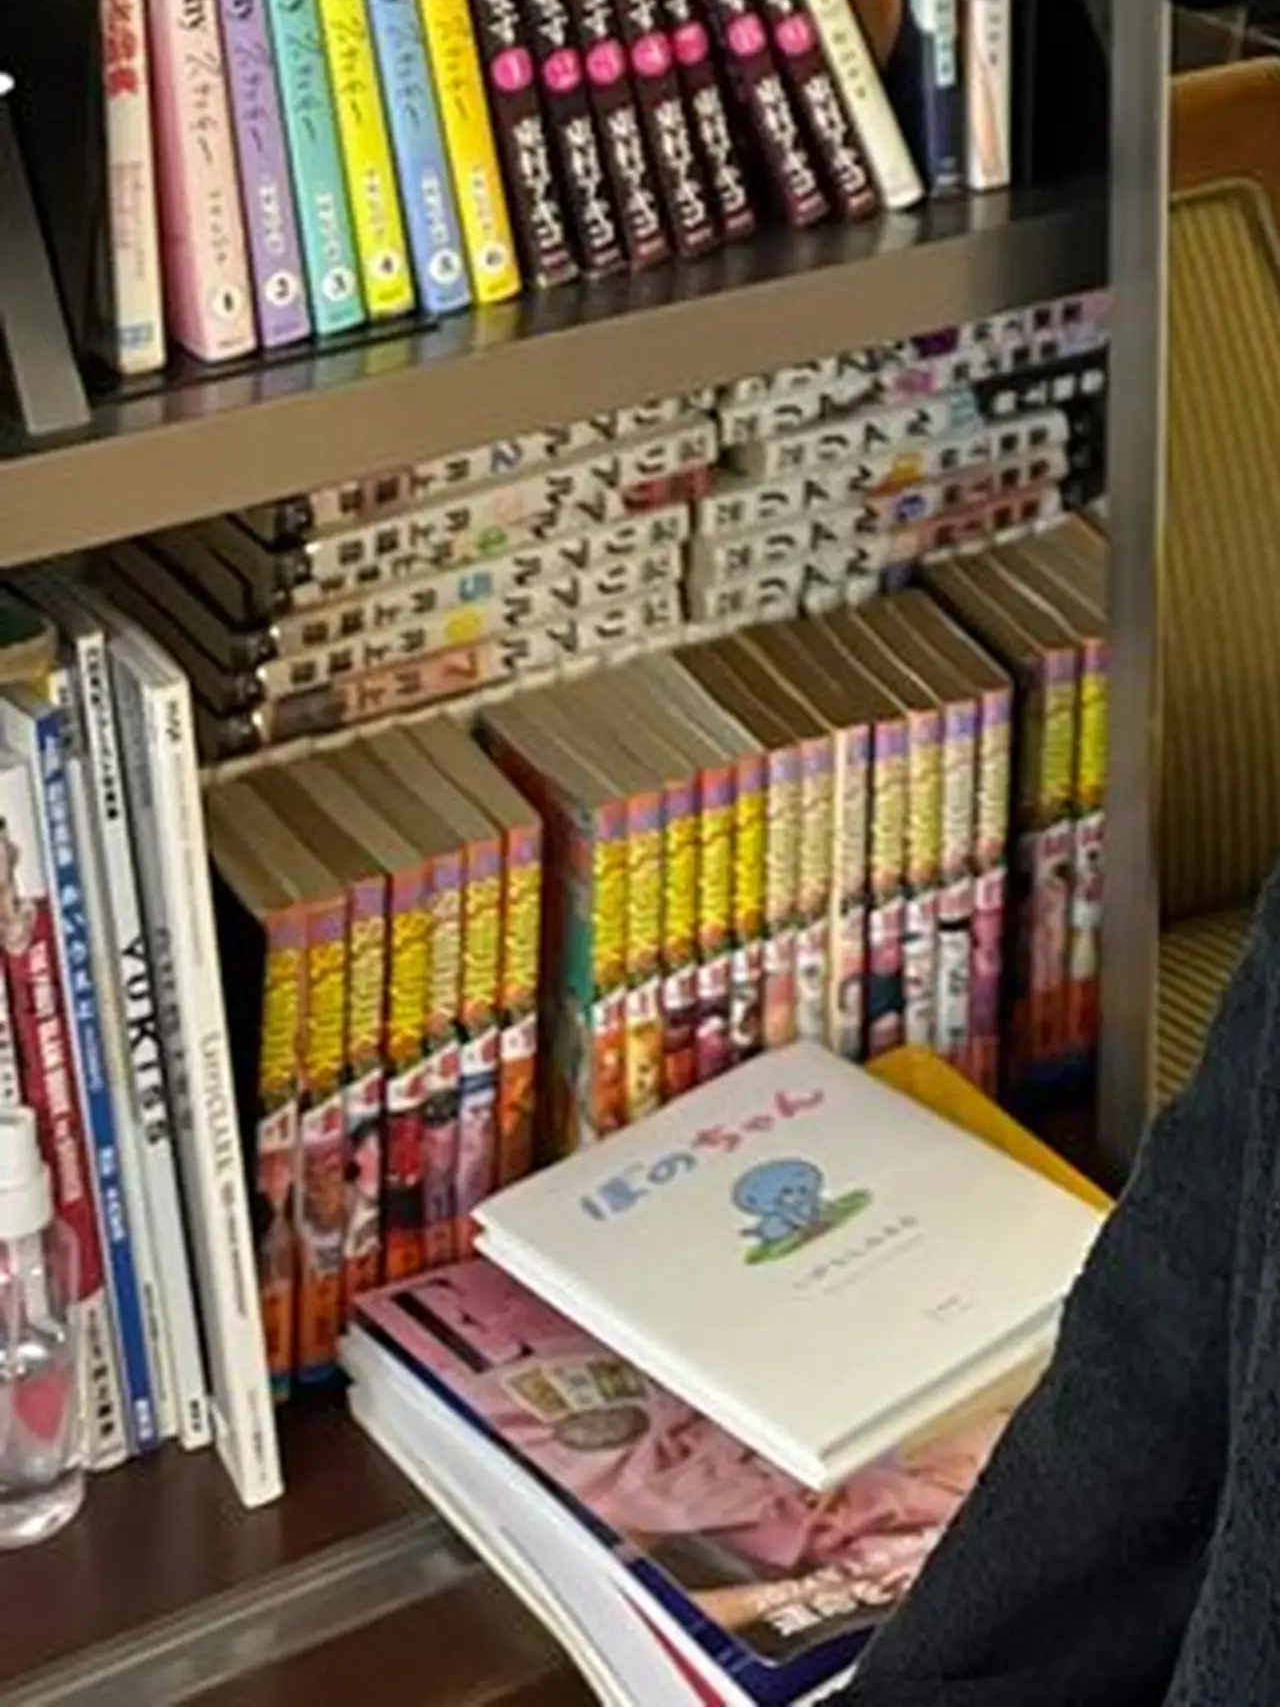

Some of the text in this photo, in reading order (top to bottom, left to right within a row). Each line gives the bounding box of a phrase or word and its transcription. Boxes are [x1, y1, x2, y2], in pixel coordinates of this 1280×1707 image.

[489, 439, 523, 474] 2
[513, 526, 637, 585] リアル
[504, 564, 627, 626] リアル
[500, 608, 626, 668] リアル
